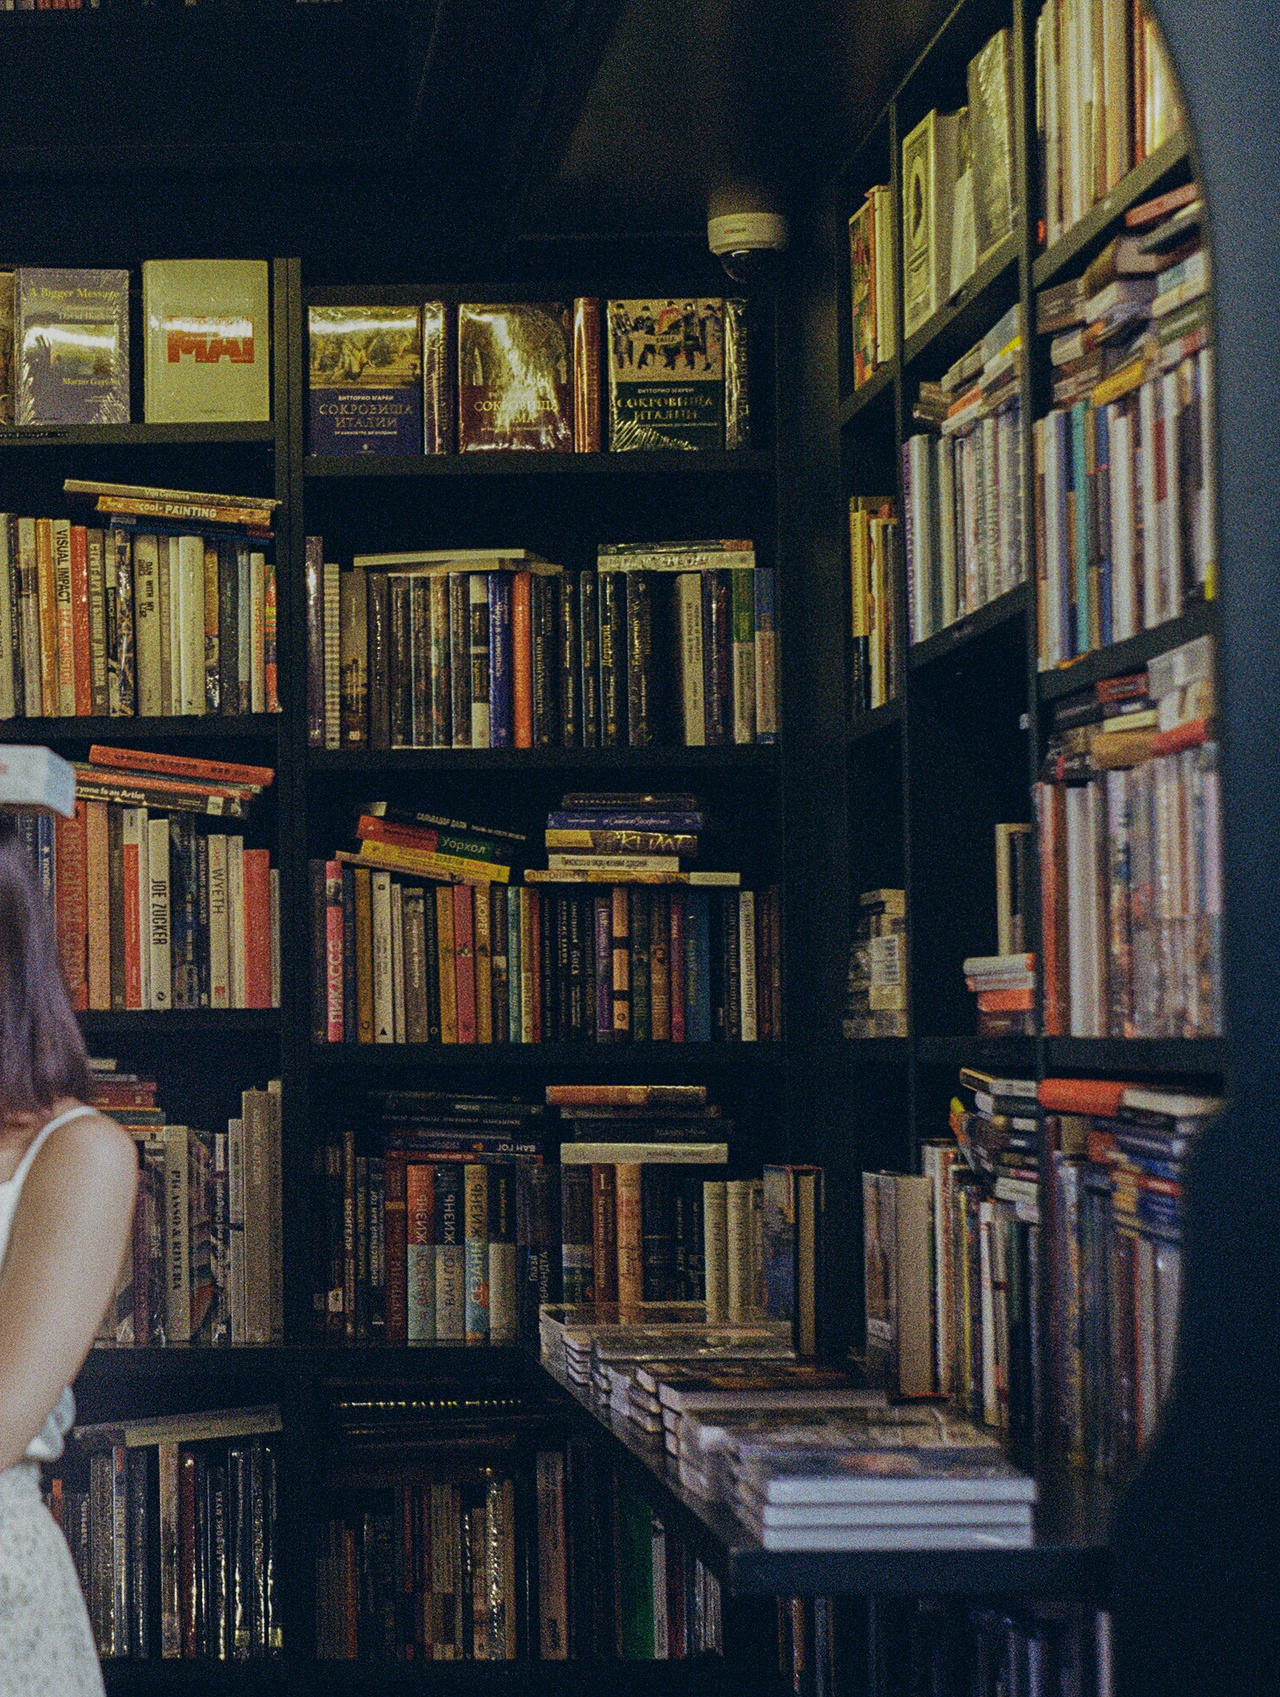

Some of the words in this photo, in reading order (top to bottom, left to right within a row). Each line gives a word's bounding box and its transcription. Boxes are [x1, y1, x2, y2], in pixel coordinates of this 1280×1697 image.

[41, 288, 73, 301] Bigger
[318, 404, 414, 415] СОКРОВИЩА
[617, 397, 714, 409] СОКРОВИЩА
[634, 410, 698, 421] ИТАЛИИ
[335, 417, 398, 428] ИТАЛИИ
[165, 505, 218, 518] PAINTING
[56, 529, 69, 566] VISUAL
[57, 567, 70, 604] IMPACT
[121, 788, 146, 799] Artist
[440, 835, 487, 856] Уорхол
[61, 820, 83, 929] ORIGINAL
[151, 878, 168, 898] JOE
[211, 868, 224, 914] WYETH
[152, 903, 168, 946] ZUCKER
[475, 893, 489, 936] ДЮРЕР
[326, 938, 343, 1023] ПИКАССО
[497, 1143, 514, 1153] ГОГ
[515, 1143, 536, 1153] ВАН
[171, 1170, 181, 1226] PICASSO
[472, 1184, 484, 1238] ЖИЗНЬ
[415, 1194, 427, 1244] ЖИЗНЬ
[442, 1194, 455, 1244] ЖИЗНЬ
[172, 1241, 182, 1290] RIVERA
[470, 1242, 483, 1304] СЕЗАНН
[443, 1278, 455, 1306] ВАН
